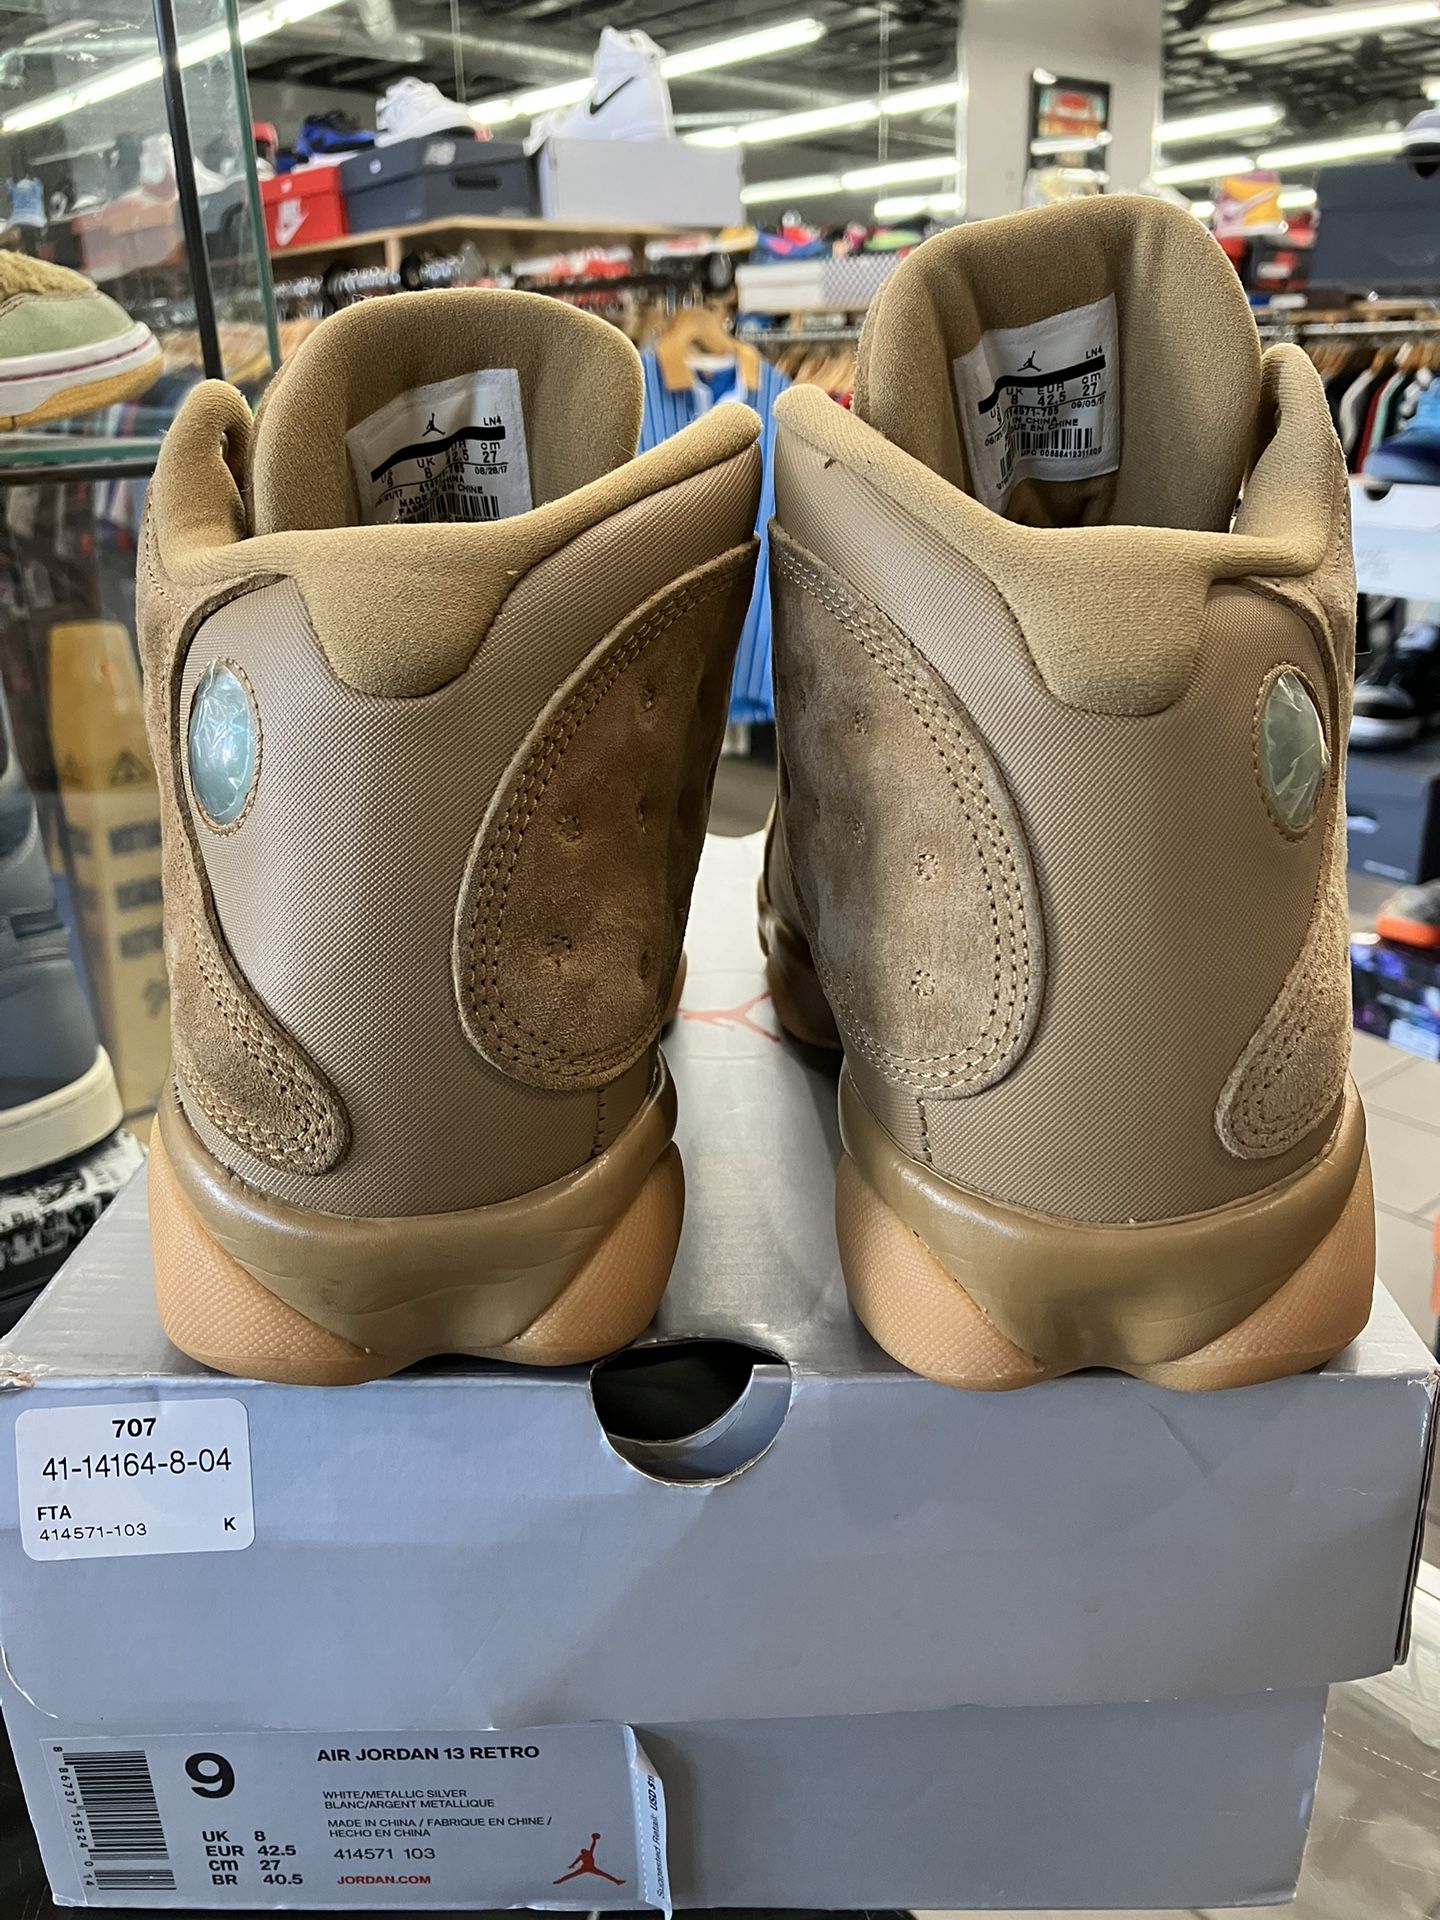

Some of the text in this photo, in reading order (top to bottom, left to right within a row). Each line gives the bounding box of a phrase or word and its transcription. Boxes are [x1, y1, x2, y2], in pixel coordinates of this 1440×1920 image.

[1085, 345, 1103, 360] LN4
[1006, 386, 1024, 396] UK
[1037, 382, 1065, 396] EUR
[1081, 371, 1101, 385] cm
[1011, 395, 1019, 405] 8
[1037, 391, 1066, 407] 42.5
[1082, 384, 1098, 397] 27
[483, 416, 502, 426] LN4
[1026, 416, 1059, 426] CHINA
[1030, 424, 1045, 432] EN
[1048, 419, 1079, 430] CHINE
[416, 457, 436, 469] UK
[480, 442, 501, 451] cm
[424, 468, 433, 479] 8
[482, 451, 498, 463] 27
[474, 466, 509, 475] 08/28/17
[457, 485, 484, 495] CHINE
[112, 1417, 157, 1438] 707
[42, 1447, 232, 1481] 41-14164-8-04
[37, 1505, 72, 1521] FTA
[224, 1517, 237, 1531] K
[39, 1522, 148, 1541] 414571-103
[317, 1745, 540, 1762] AIR JORDAN 13 RETRO
[184, 1752, 236, 1799] 9
[323, 1789, 468, 1799] WHITE/METALLIC SILVER
[647, 1789, 658, 1811] USD
[58, 1766, 77, 1805] 86737
[70, 1812, 89, 1849] 15524
[324, 1799, 495, 1810] BLANC/ARGENT METALLIQUE
[327, 1819, 361, 1828] MADE
[364, 1819, 377, 1828] IN
[379, 1818, 417, 1828] CHINA
[427, 1818, 486, 1828] FABRIQUE
[488, 1817, 506, 1827] EN
[507, 1816, 545, 1826] CHINE
[202, 1830, 266, 1843] UK 8
[329, 1828, 431, 1838] HECHO EN CHINA
[651, 1813, 660, 1846] Retail:
[205, 1845, 297, 1857] EUR 42.5
[333, 1848, 436, 1860] 414571 103
[208, 1859, 281, 1872] cm 27
[654, 1845, 665, 1899] Suggested
[212, 1873, 304, 1885] BR 40.5
[337, 1875, 431, 1885] JORDAN.COM
